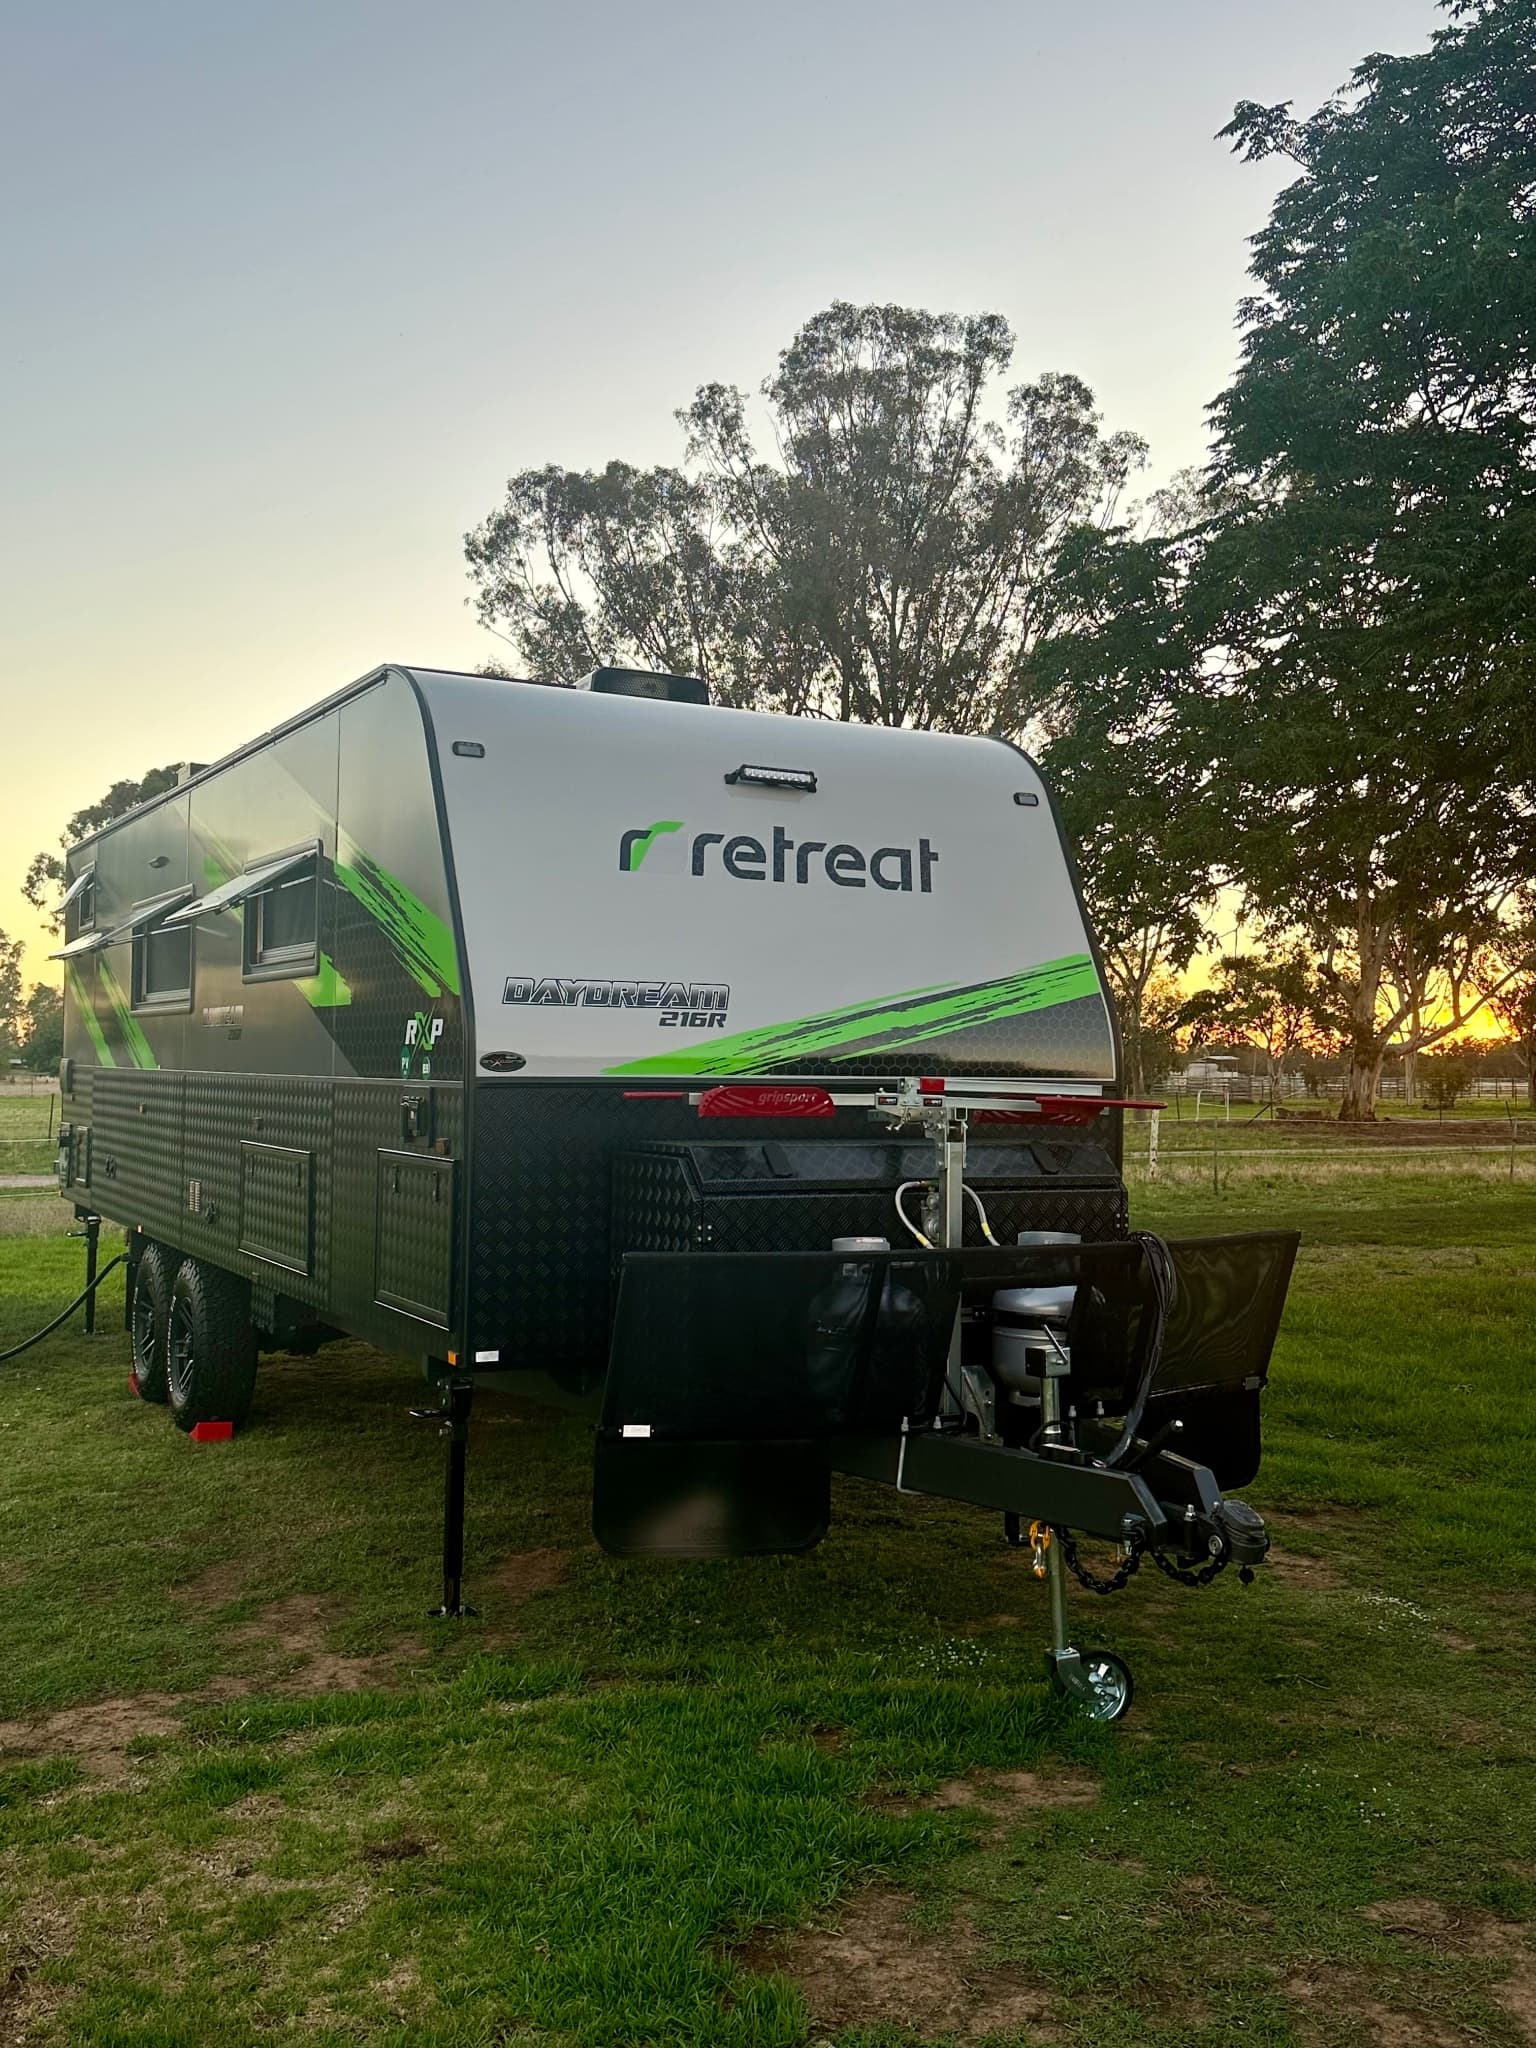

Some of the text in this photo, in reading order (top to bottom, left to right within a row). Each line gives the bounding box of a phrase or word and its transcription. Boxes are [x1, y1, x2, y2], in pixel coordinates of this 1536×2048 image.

[691, 826, 939, 893] retreat
[502, 976, 730, 1011] DAYDREAM
[404, 1011, 444, 1051] RXP
[658, 1011, 728, 1028] 216R
[757, 1091, 818, 1105] gripsport
